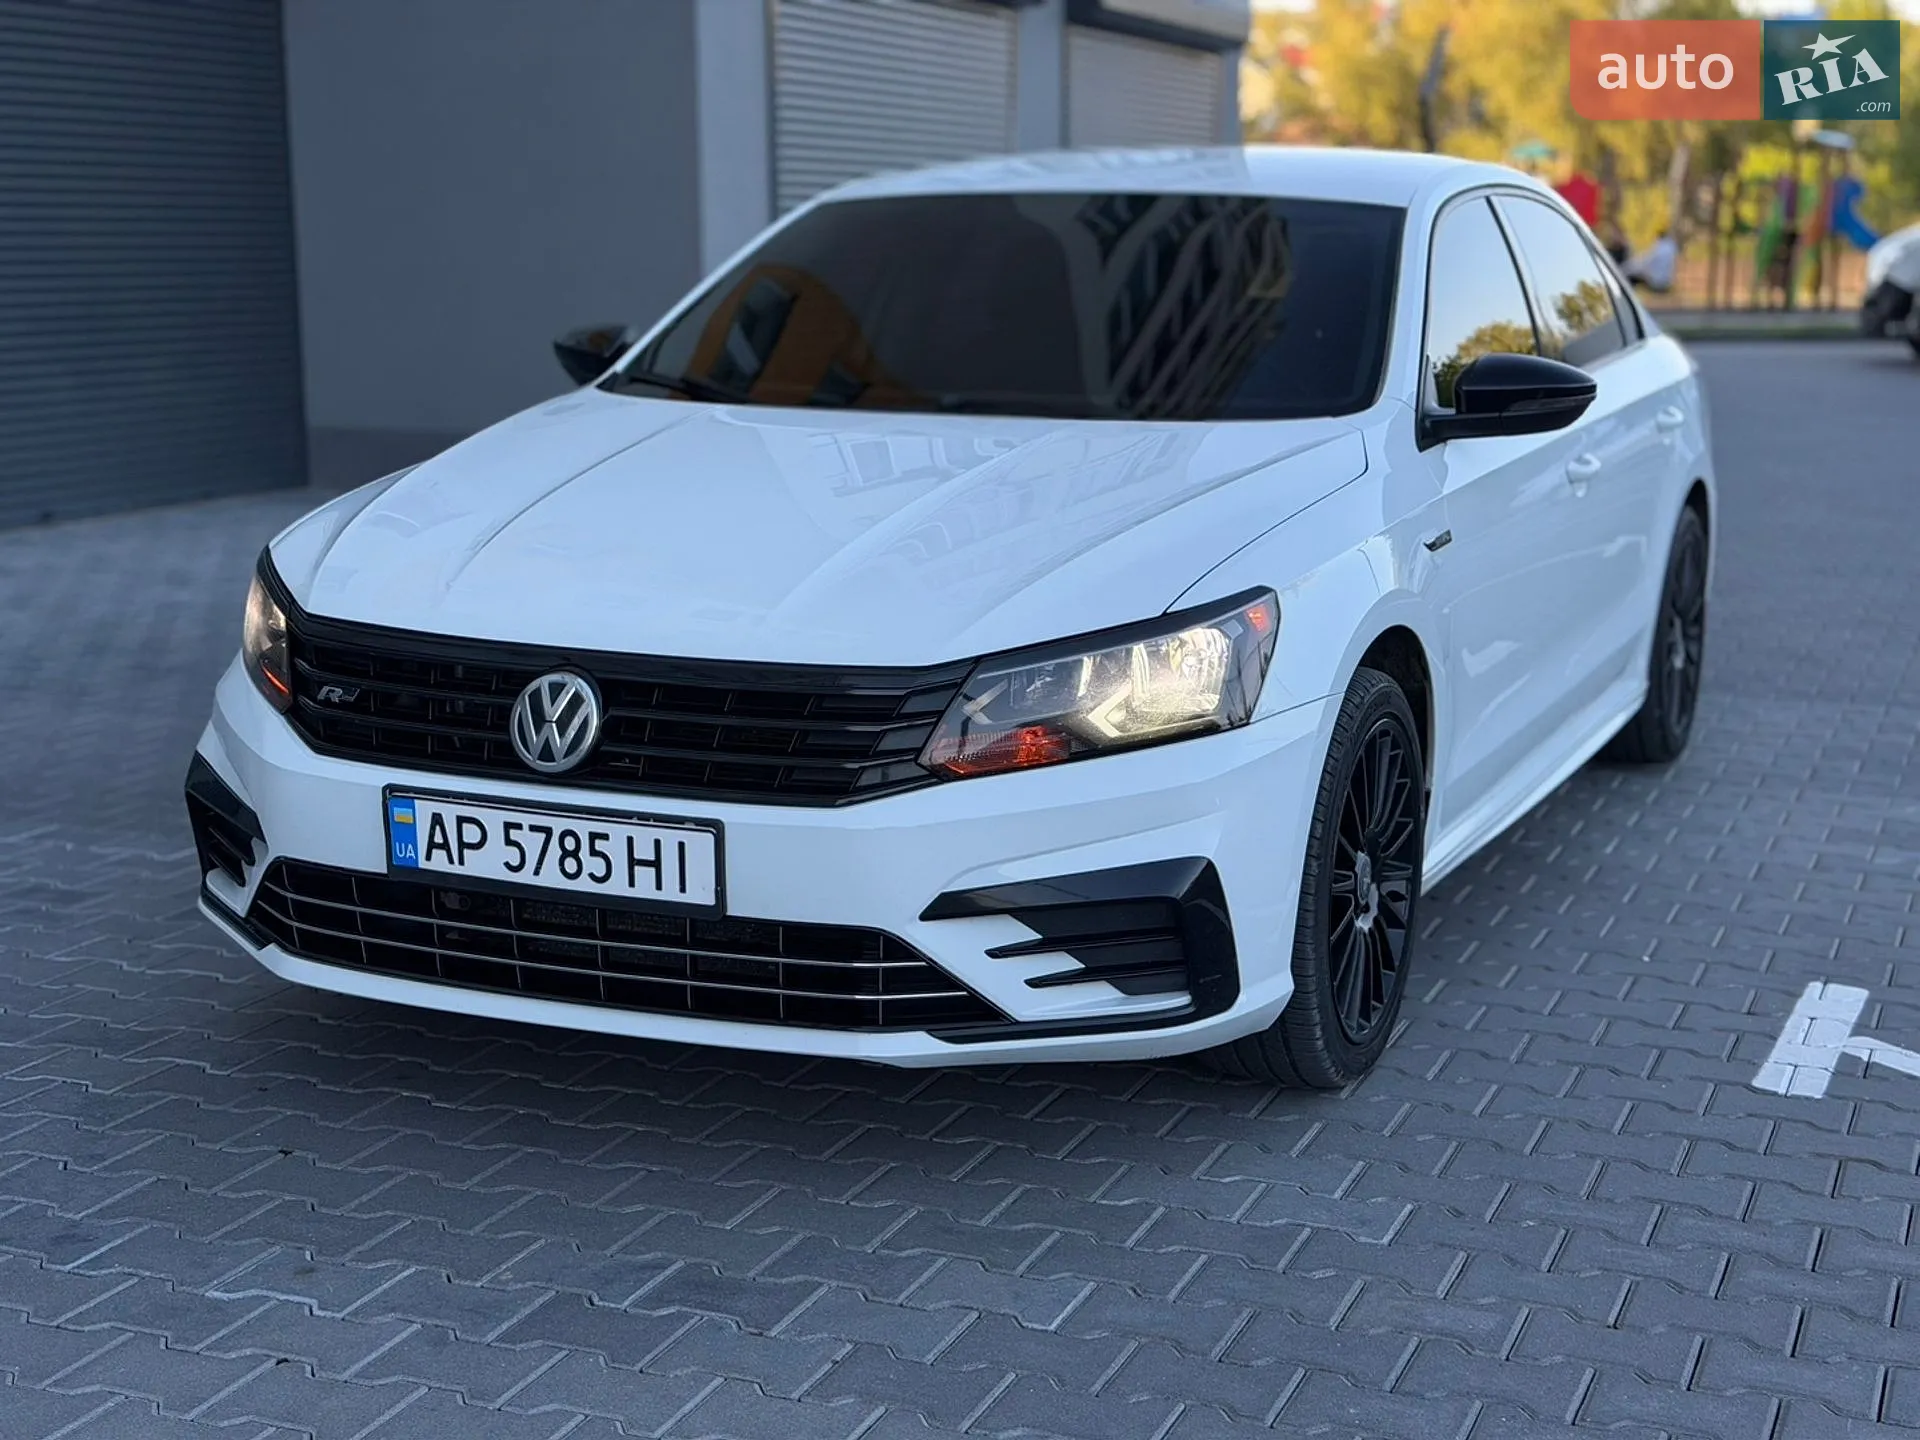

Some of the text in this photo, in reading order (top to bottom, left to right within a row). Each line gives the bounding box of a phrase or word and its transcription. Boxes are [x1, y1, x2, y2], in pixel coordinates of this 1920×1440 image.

[395, 841, 416, 860] UA
[425, 812, 687, 894] AP 5785 HI
